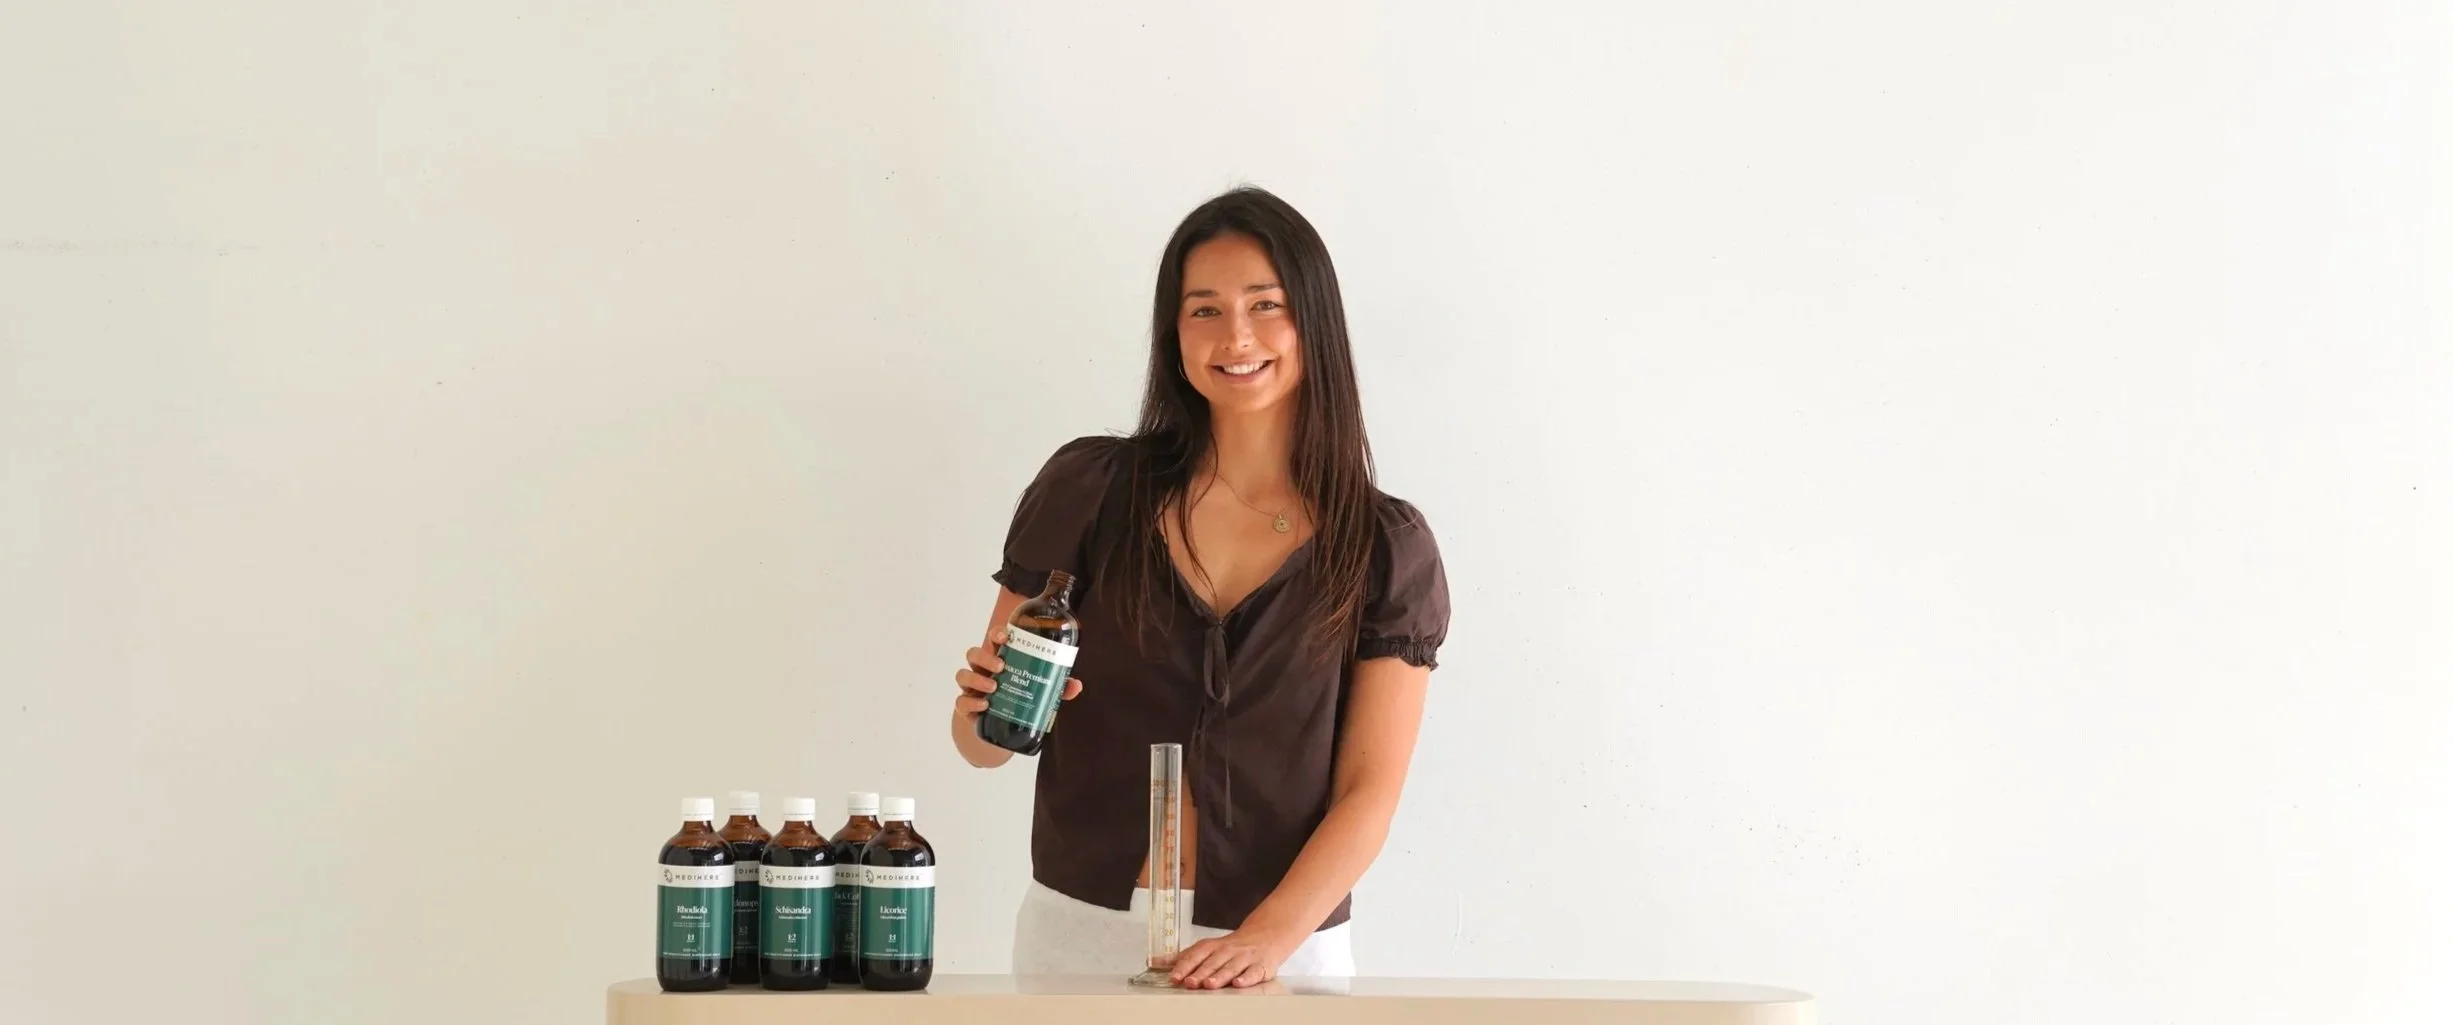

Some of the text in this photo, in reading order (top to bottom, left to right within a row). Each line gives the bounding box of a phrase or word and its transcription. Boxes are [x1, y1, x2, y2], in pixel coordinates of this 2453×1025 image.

[1010, 674, 1030, 687] Blend
[676, 905, 708, 914] Rhodiola
[775, 905, 812, 915] Schisandra
[880, 905, 908, 914] Licorice
